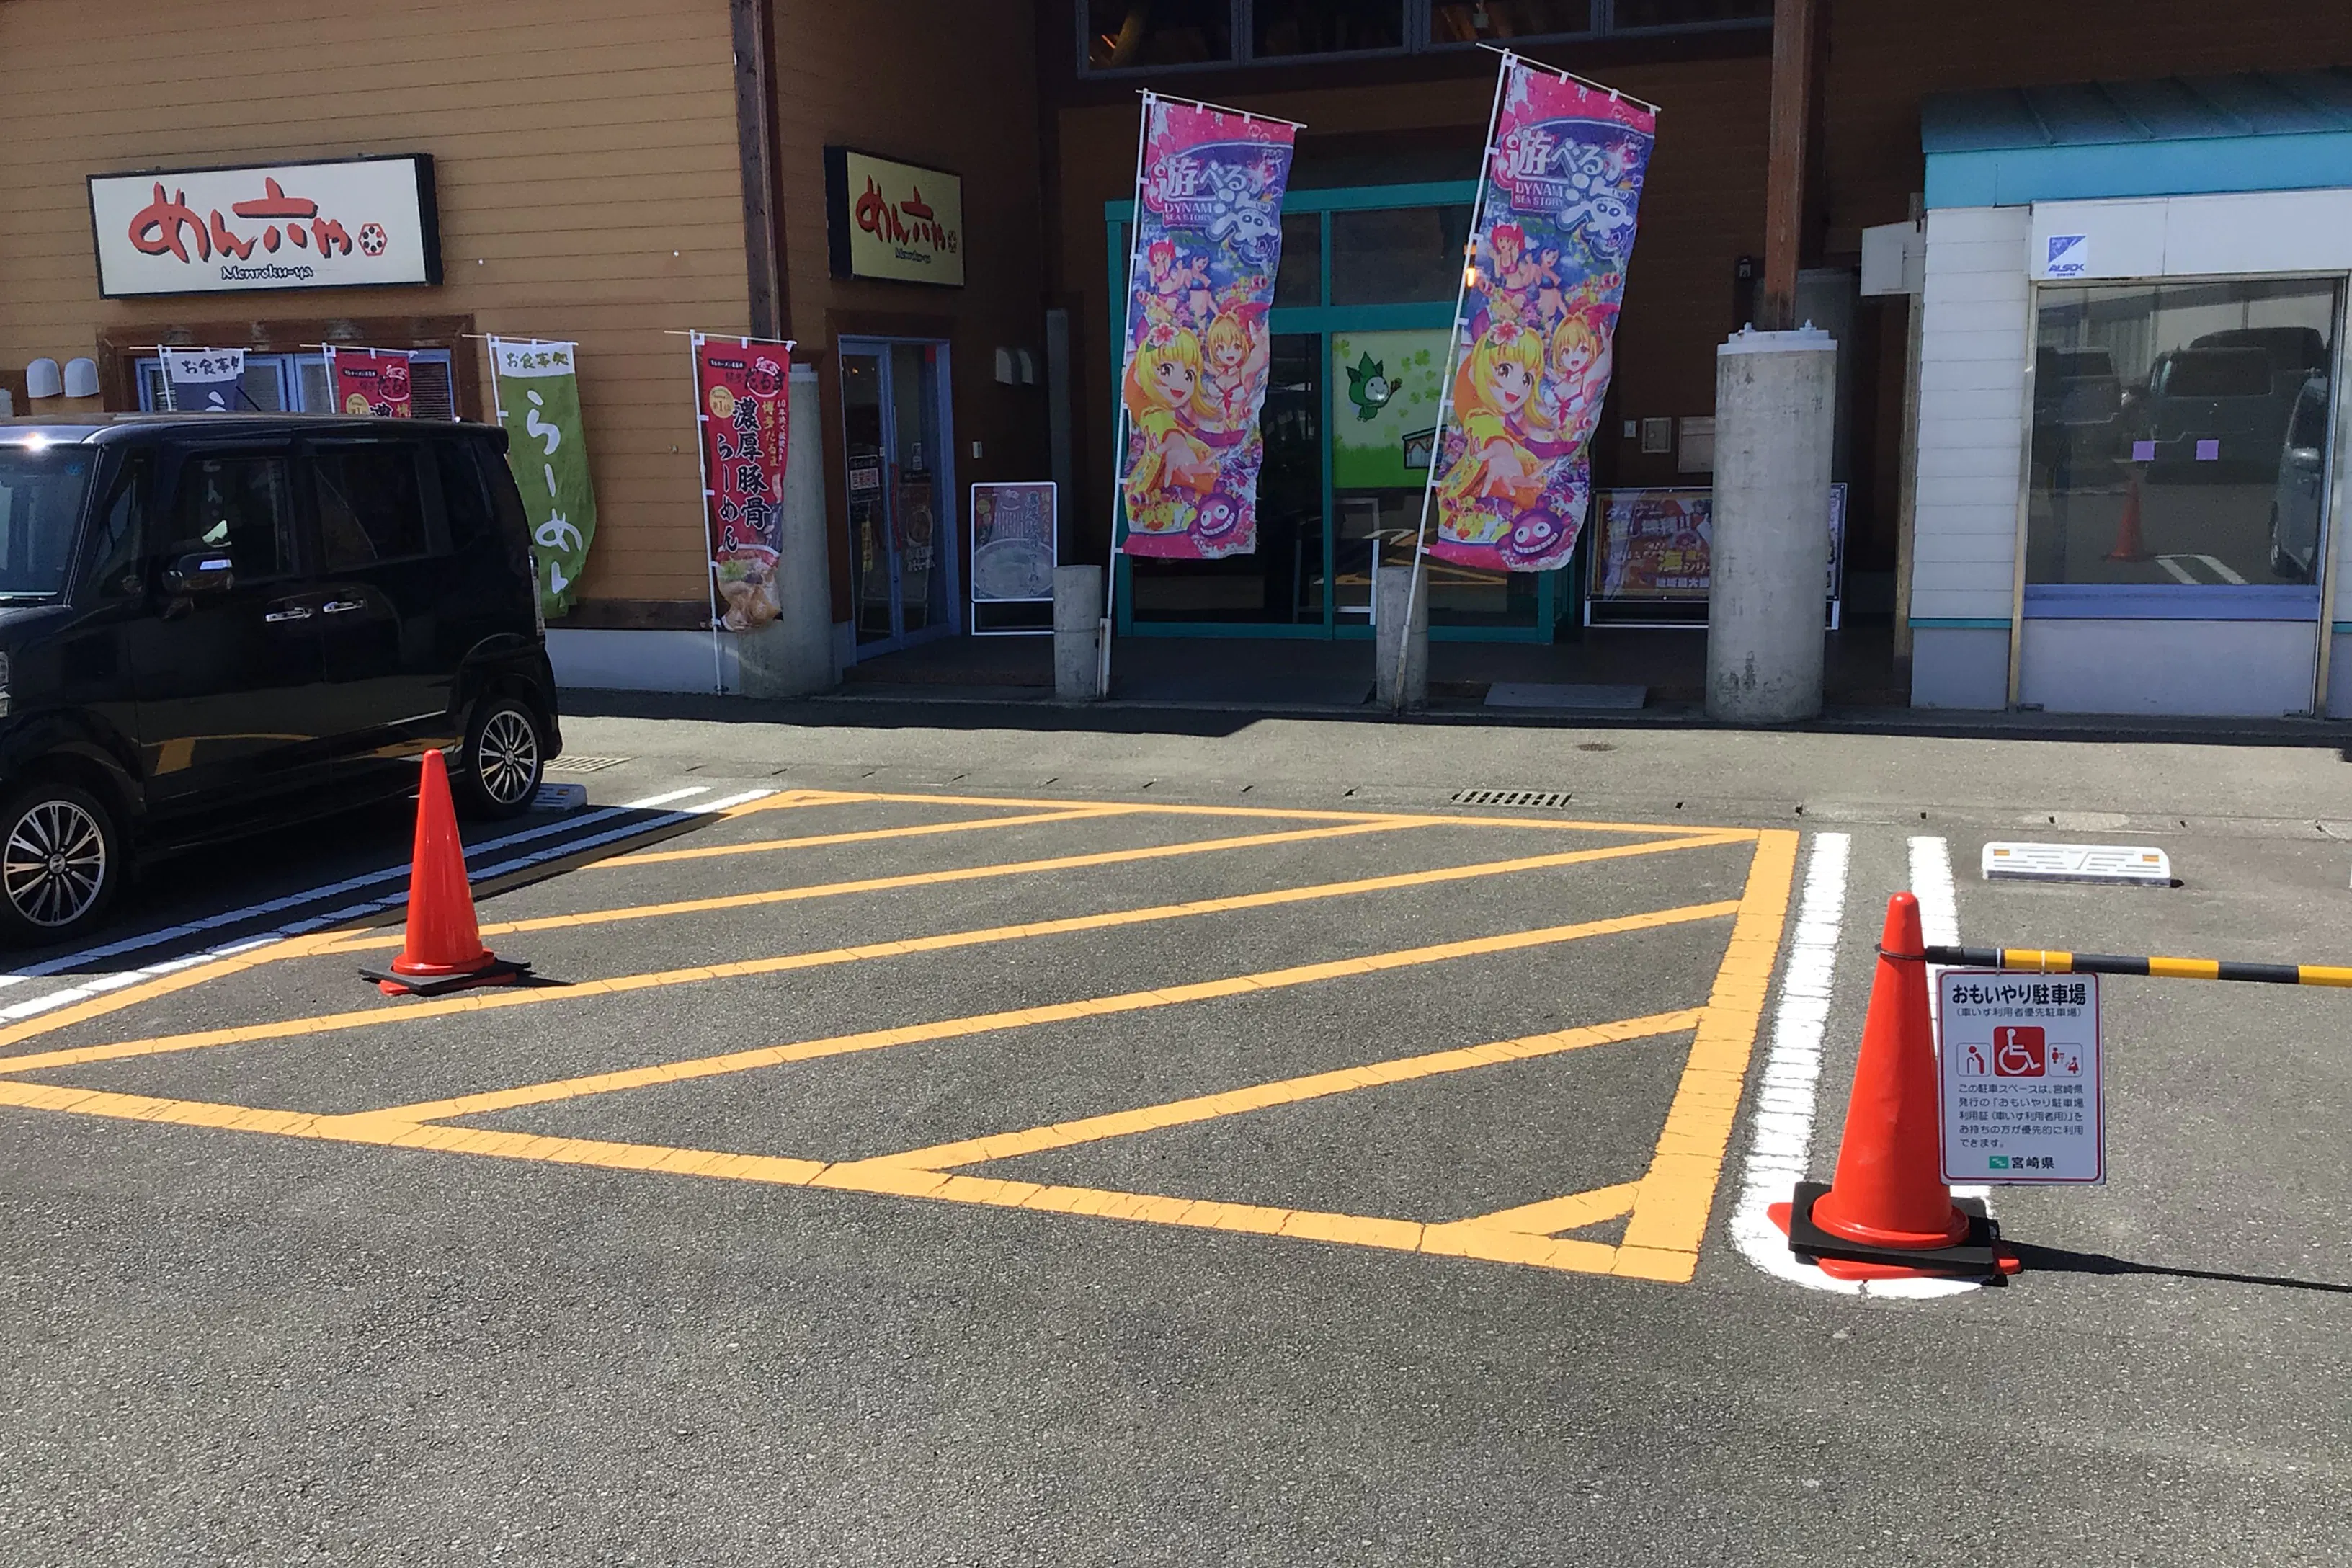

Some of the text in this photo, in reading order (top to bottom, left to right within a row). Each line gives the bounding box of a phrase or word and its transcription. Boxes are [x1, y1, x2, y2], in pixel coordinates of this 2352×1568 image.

[1515, 181, 1563, 198] DYNAM
[1164, 202, 1213, 214] DYNAM
[221, 263, 313, 282] Menroku-ya
[2049, 264, 2085, 272] ALSOK
[507, 352, 569, 368] お食事処
[734, 398, 772, 530] 濃厚豚骨
[716, 434, 739, 553] らーめん
[1951, 983, 2087, 1005] おもいやり駐車場
[1959, 1083, 2083, 1094] この駐車スペースは、宮崎県
[1959, 1097, 2084, 1108] 発行の「おもいやり駐車場
[1959, 1124, 2084, 1135] お持ちの方が優先的に利用
[1959, 1138, 2005, 1149] できます。
[2011, 1156, 2055, 1170] 宮崎県
